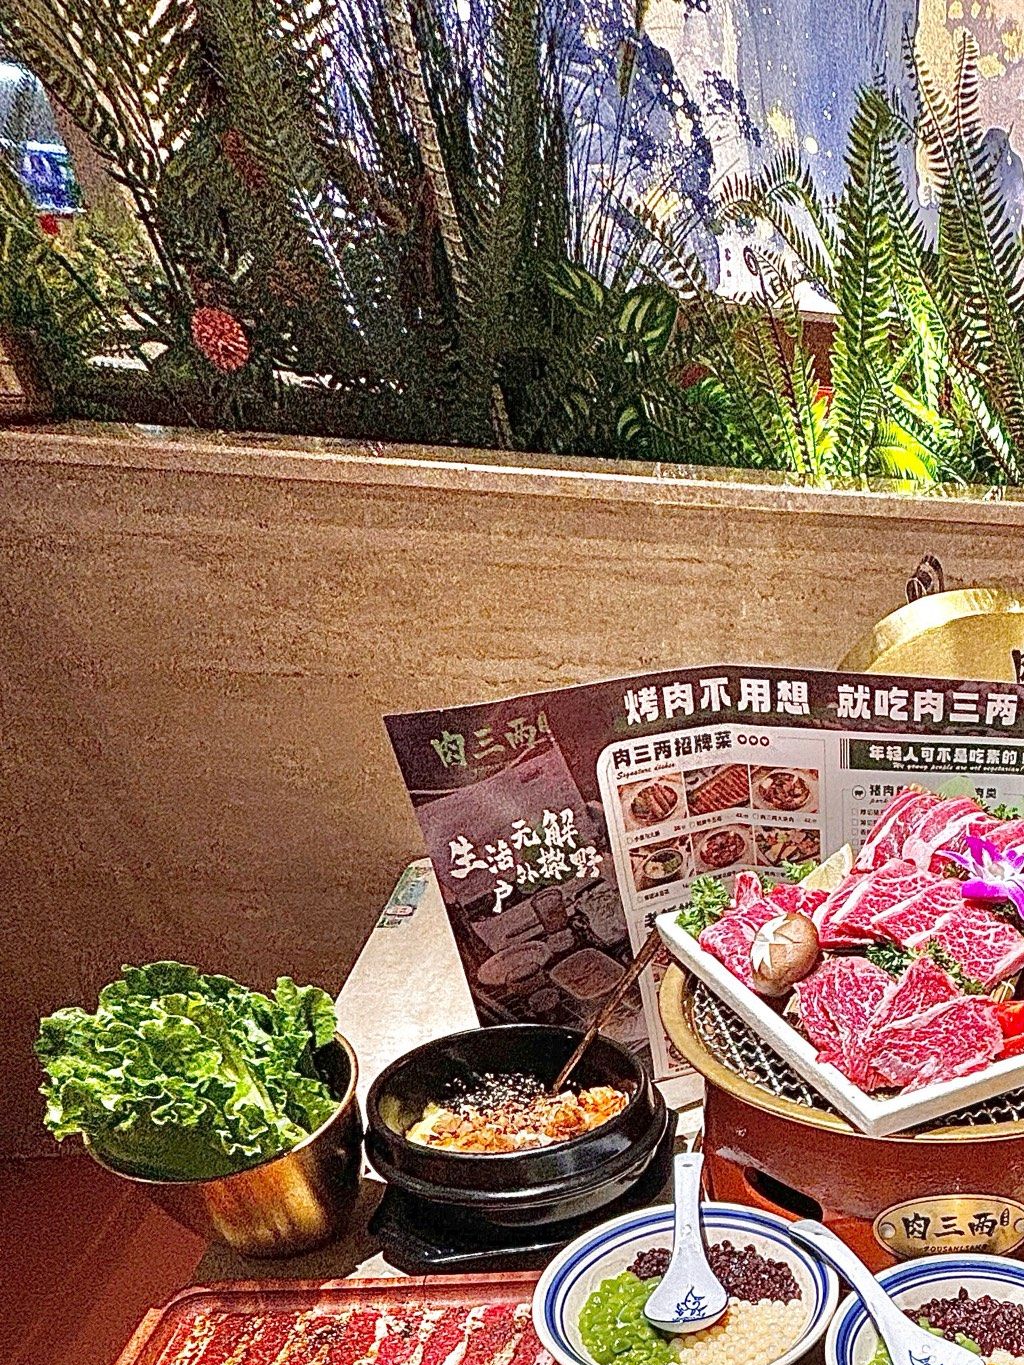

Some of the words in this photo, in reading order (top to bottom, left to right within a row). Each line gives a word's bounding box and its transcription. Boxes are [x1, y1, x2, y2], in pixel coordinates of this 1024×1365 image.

[623, 676, 811, 726] 烤肉不用想
[837, 684, 1018, 726] 就吃肉三两
[612, 730, 733, 770] 肉三两招牌菜
